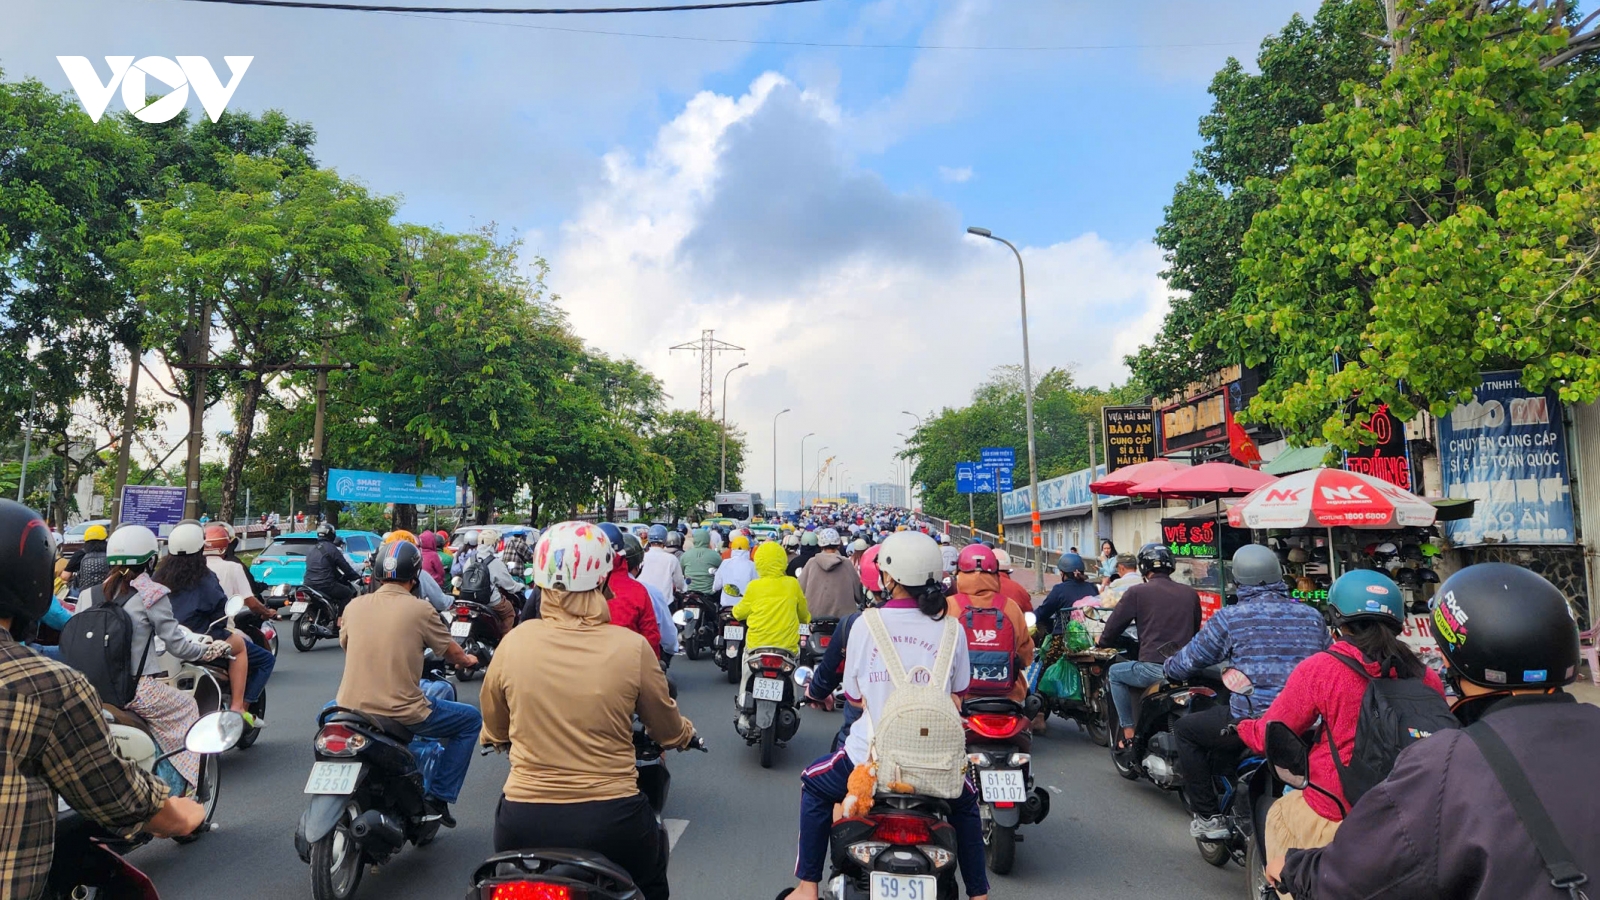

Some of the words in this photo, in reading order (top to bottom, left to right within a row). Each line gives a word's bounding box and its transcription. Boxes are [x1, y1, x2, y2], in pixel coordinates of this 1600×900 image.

[1486, 380, 1513, 391] TNHH
[1124, 410, 1136, 420] HẢI
[1137, 410, 1151, 420] SẢN
[1108, 421, 1132, 434] BẢO
[1135, 423, 1152, 433] AN
[1110, 437, 1134, 445] CUNG
[1135, 434, 1152, 445] CẤP
[1450, 433, 1495, 453] CHUYÊN
[1498, 433, 1531, 448] CUNG
[1534, 430, 1557, 447] CẤP
[1117, 454, 1131, 464] HẢI
[1132, 454, 1148, 464] SẢN
[1463, 458, 1470, 471] &
[1527, 449, 1559, 467] QUỐC
[356, 479, 382, 487] SMART
[1266, 488, 1306, 501] NK
[1320, 485, 1370, 500] NK
[1190, 521, 1214, 543] SỐ
[1445, 590, 1469, 626] AXE
[972, 629, 997, 641] VUS
[758, 680, 780, 690] 59-X2
[755, 688, 781, 699] 782.17
[318, 764, 352, 777] 55-Y1
[314, 777, 349, 791] 5250
[987, 773, 1017, 786] 61-B2
[985, 787, 1022, 800] 501.07
[881, 877, 924, 900] 59-S1
